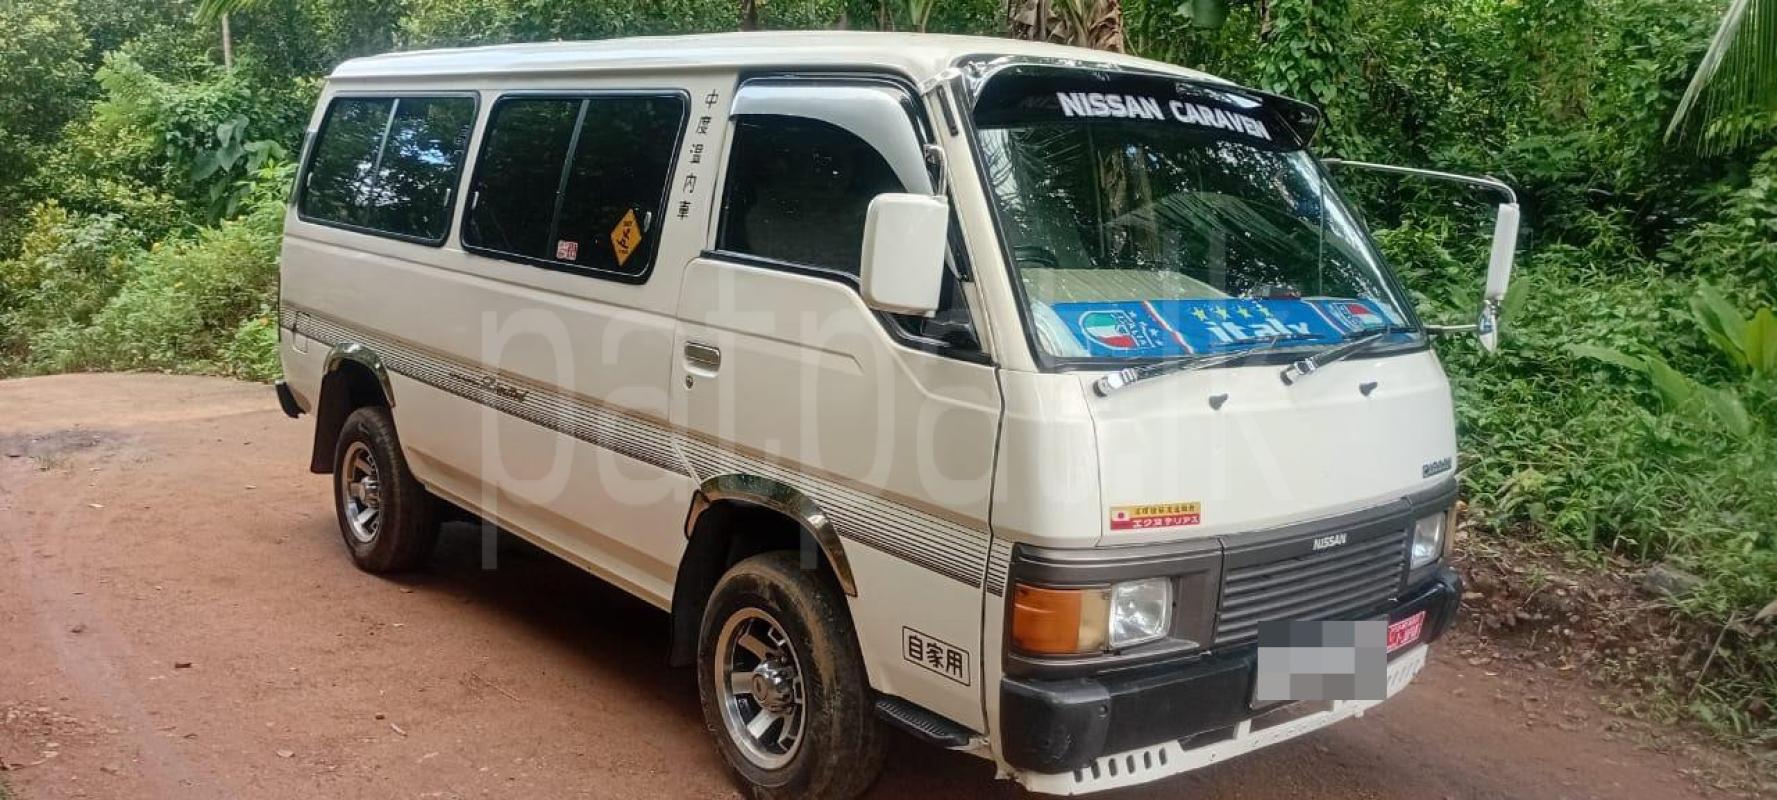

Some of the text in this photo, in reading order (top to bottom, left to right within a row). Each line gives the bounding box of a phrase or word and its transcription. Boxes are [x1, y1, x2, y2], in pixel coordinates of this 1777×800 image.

[1056, 92, 1272, 141] NISSAN CARAVEN
[1312, 533, 1348, 550] NISSAN
[908, 635, 963, 678] 自家用
